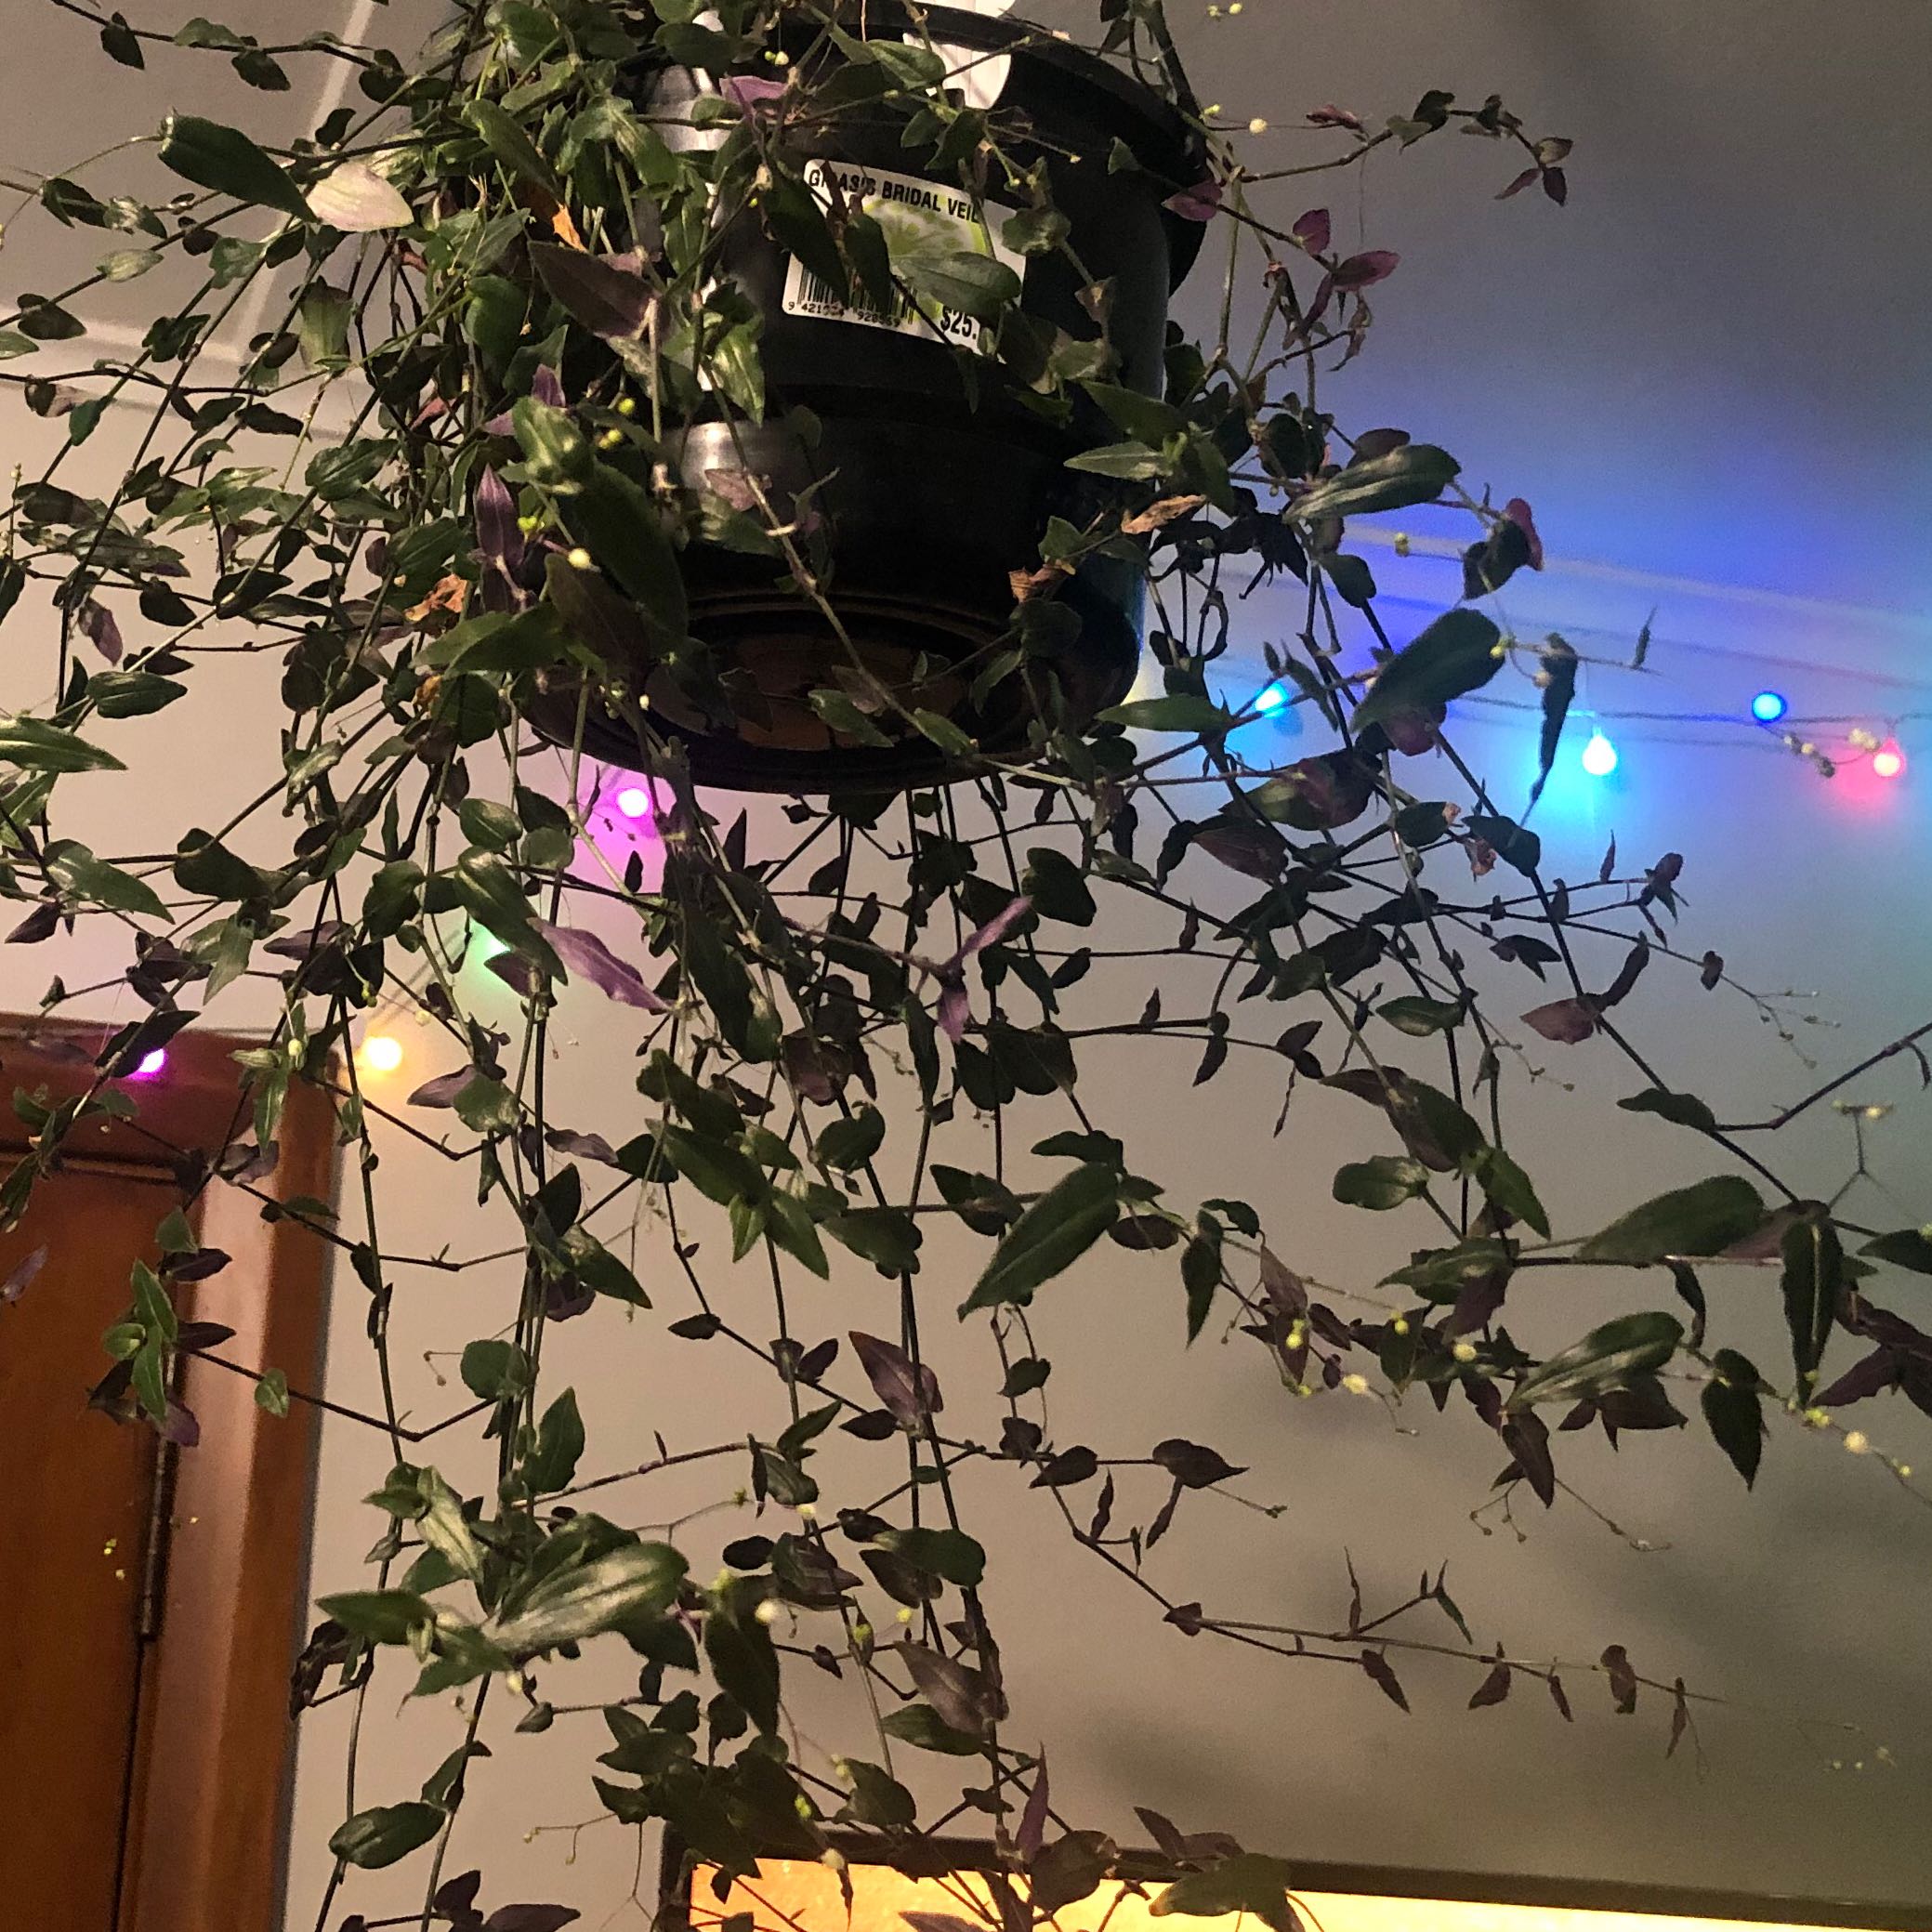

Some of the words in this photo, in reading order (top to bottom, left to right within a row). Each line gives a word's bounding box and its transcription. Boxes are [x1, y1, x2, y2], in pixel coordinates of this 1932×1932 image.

[882, 180, 940, 212] BRIDAL
[948, 198, 979, 223] VEIL
[788, 301, 795, 310] 9
